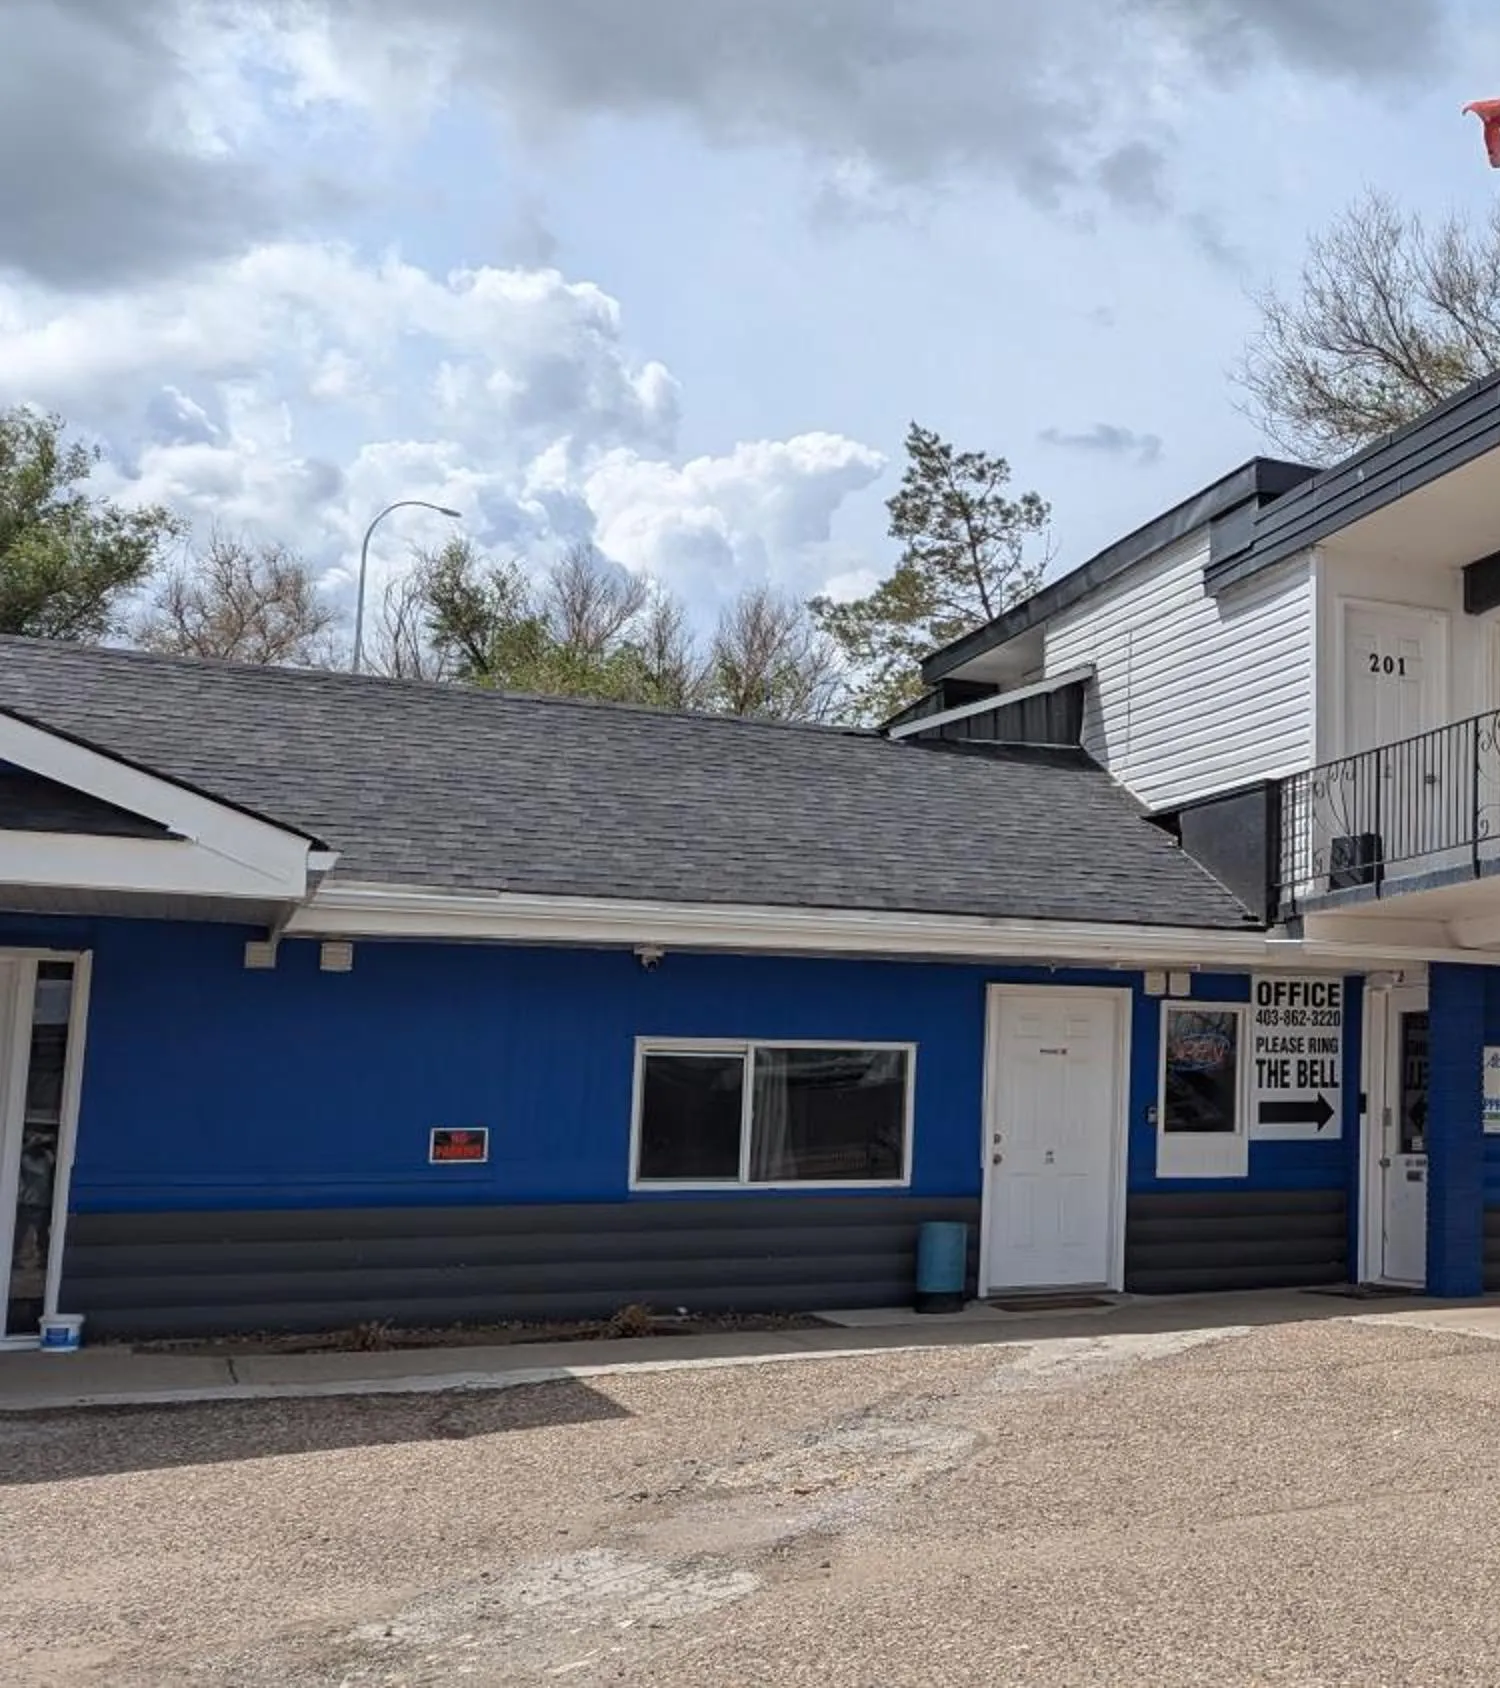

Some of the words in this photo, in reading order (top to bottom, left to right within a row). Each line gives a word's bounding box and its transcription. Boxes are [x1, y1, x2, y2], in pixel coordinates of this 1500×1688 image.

[1369, 653, 1405, 676] 201
[1257, 981, 1341, 1008] OFFICE
[1255, 1009, 1341, 1027] 403-862-3220
[1256, 1036, 1304, 1053] PLEASE
[1308, 1037, 1339, 1054] RING
[1255, 1058, 1290, 1089] THE
[1297, 1058, 1340, 1089] BELL
